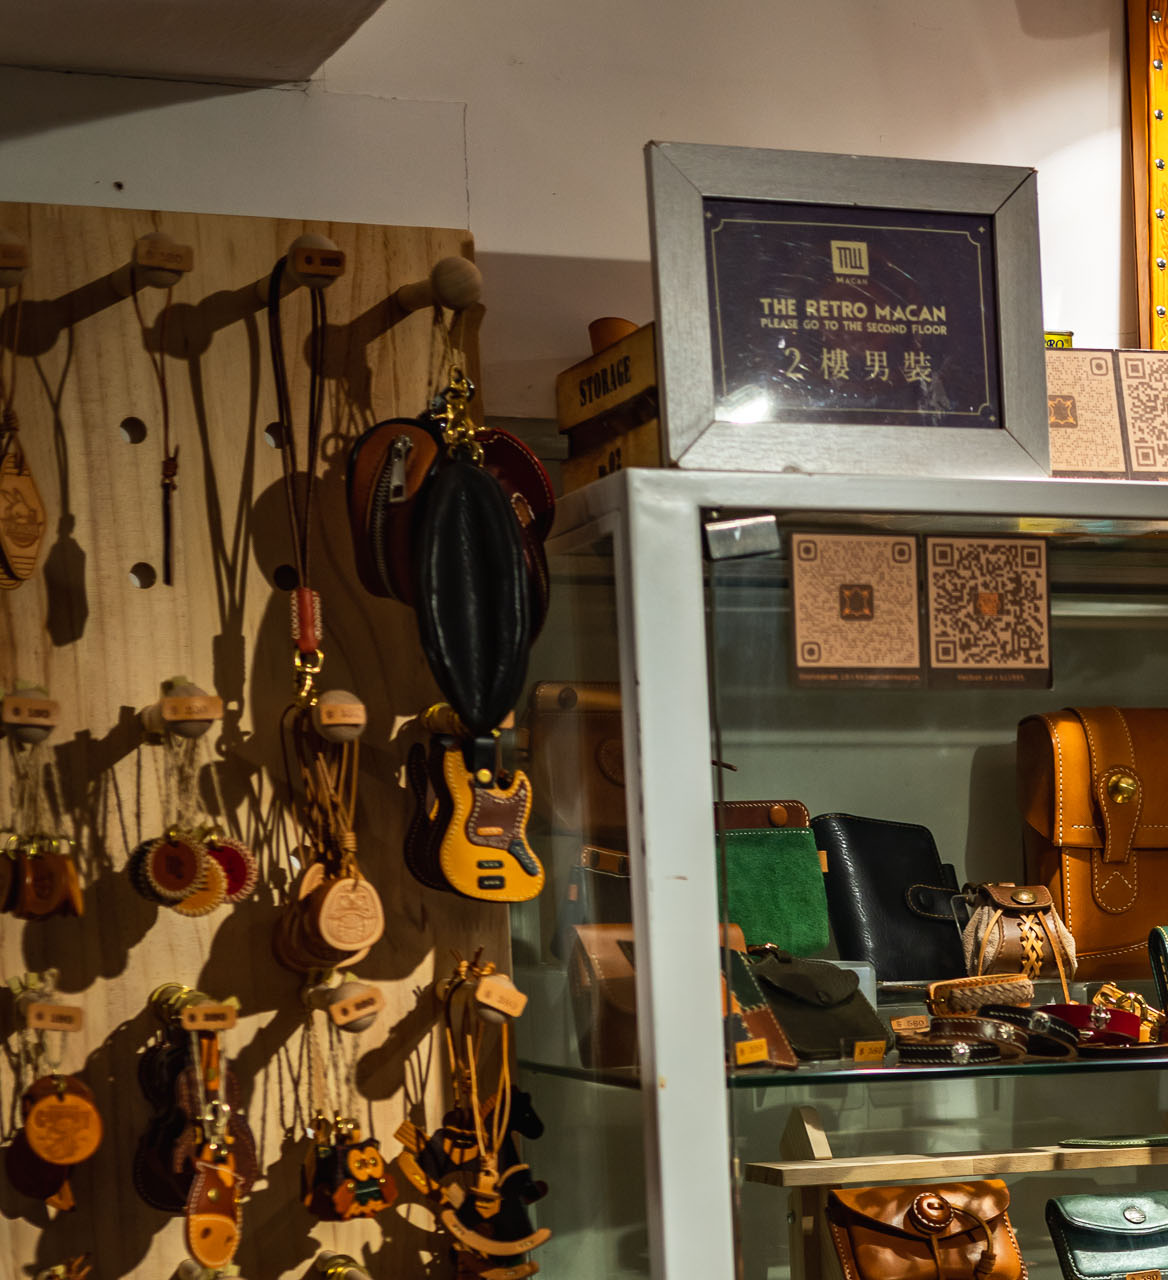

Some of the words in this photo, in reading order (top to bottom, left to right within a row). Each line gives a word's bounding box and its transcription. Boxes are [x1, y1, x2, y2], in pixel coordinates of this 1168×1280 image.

[835, 276, 868, 286] MACAN
[760, 298, 796, 316] THE
[806, 300, 867, 319] RETRO
[875, 303, 947, 322] MACAN
[761, 317, 799, 330] PLEASE
[803, 319, 820, 331] GO
[824, 320, 839, 332] TO
[843, 321, 863, 332] THE
[866, 322, 907, 334] SECOND
[912, 324, 947, 336] FLOOR
[579, 355, 632, 407] STORAGE
